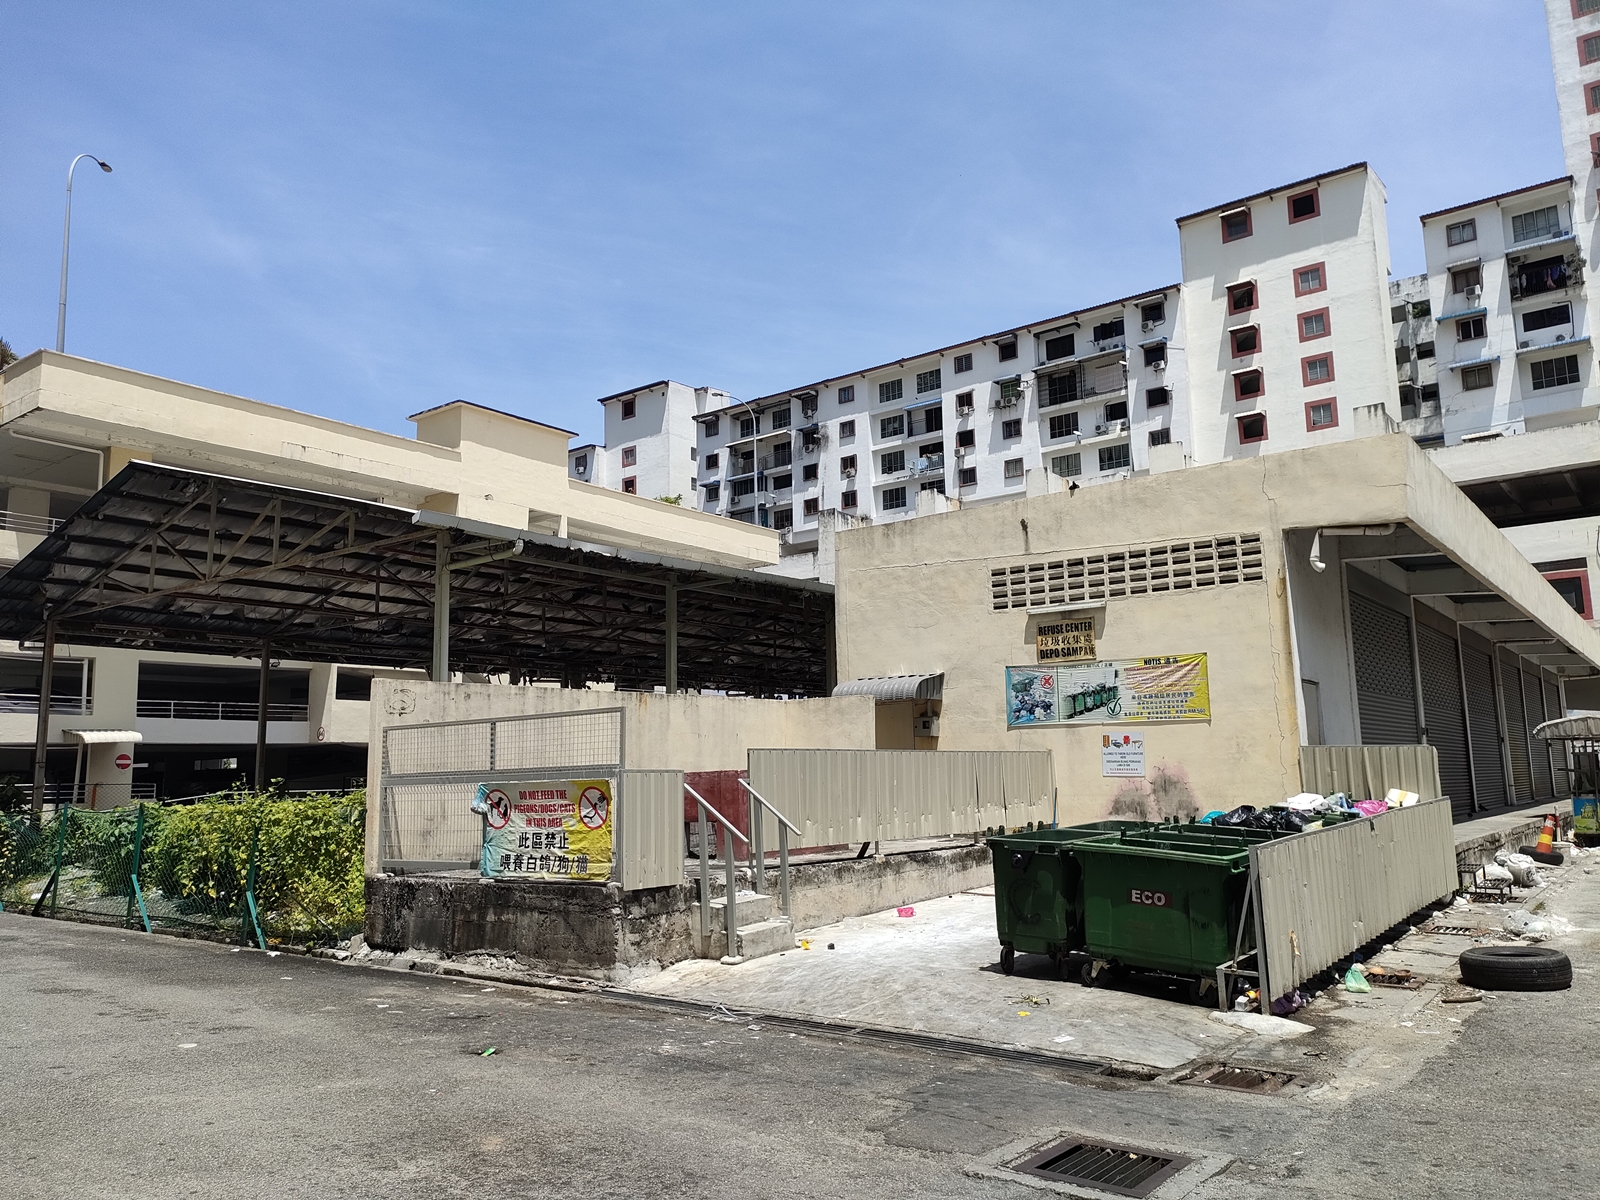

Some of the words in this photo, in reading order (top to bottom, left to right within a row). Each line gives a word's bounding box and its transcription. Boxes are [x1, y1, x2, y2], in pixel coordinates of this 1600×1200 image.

[1038, 624, 1064, 636] REFUSE
[1065, 621, 1092, 633] CENTER
[1040, 648, 1060, 659] DEPO
[1143, 658, 1162, 666] NOTIS
[519, 790, 527, 800] DO
[527, 790, 540, 800] NOT
[540, 790, 555, 799] FEED
[555, 789, 567, 799] THE
[525, 818, 533, 827] IN
[533, 818, 547, 827] THIS
[547, 818, 563, 827] AREA
[518, 832, 570, 849] 此區禁止
[1131, 889, 1166, 906] ECO
